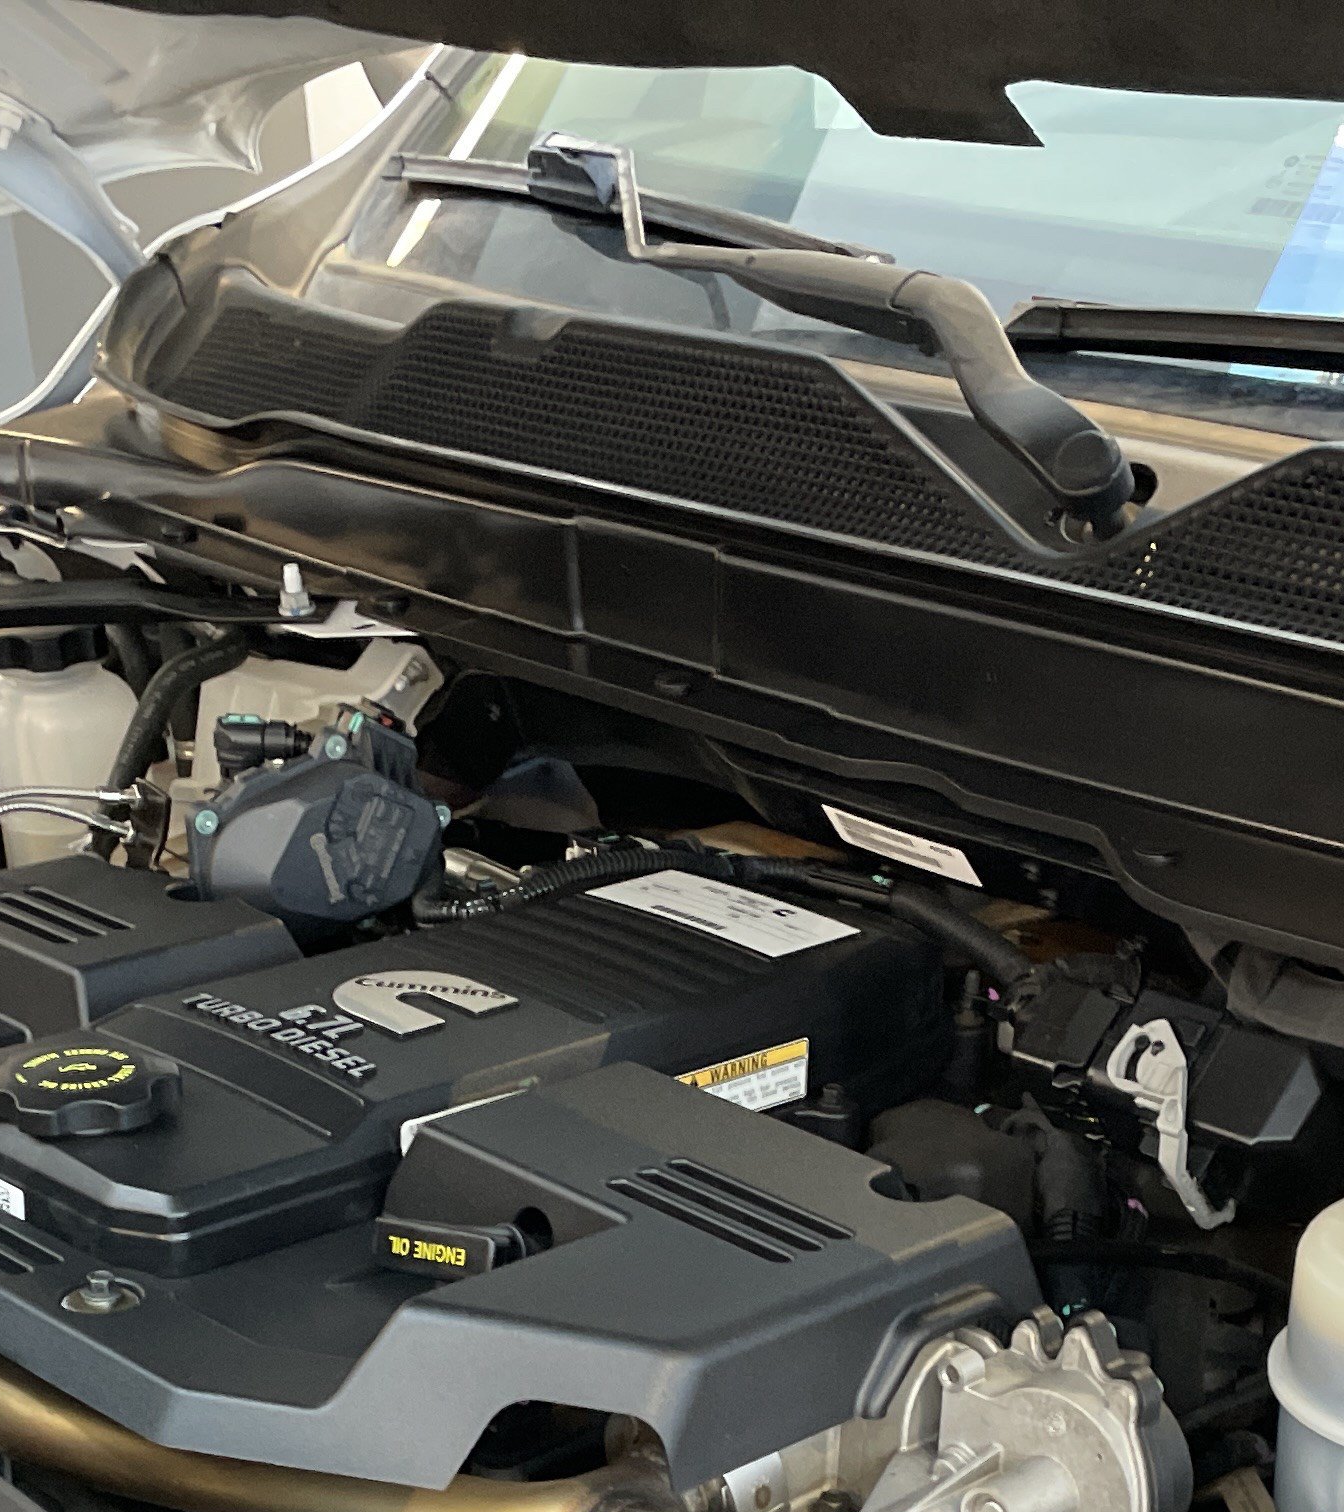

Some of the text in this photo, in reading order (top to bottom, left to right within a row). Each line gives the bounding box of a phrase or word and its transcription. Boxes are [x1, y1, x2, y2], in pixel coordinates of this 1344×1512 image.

[355, 977, 506, 1000] Cummins
[183, 992, 377, 1079] TURBO DIESEL
[278, 1004, 364, 1041] 6.7L
[709, 1051, 769, 1084] WARNING
[388, 1234, 467, 1267] ENGINE OIL
